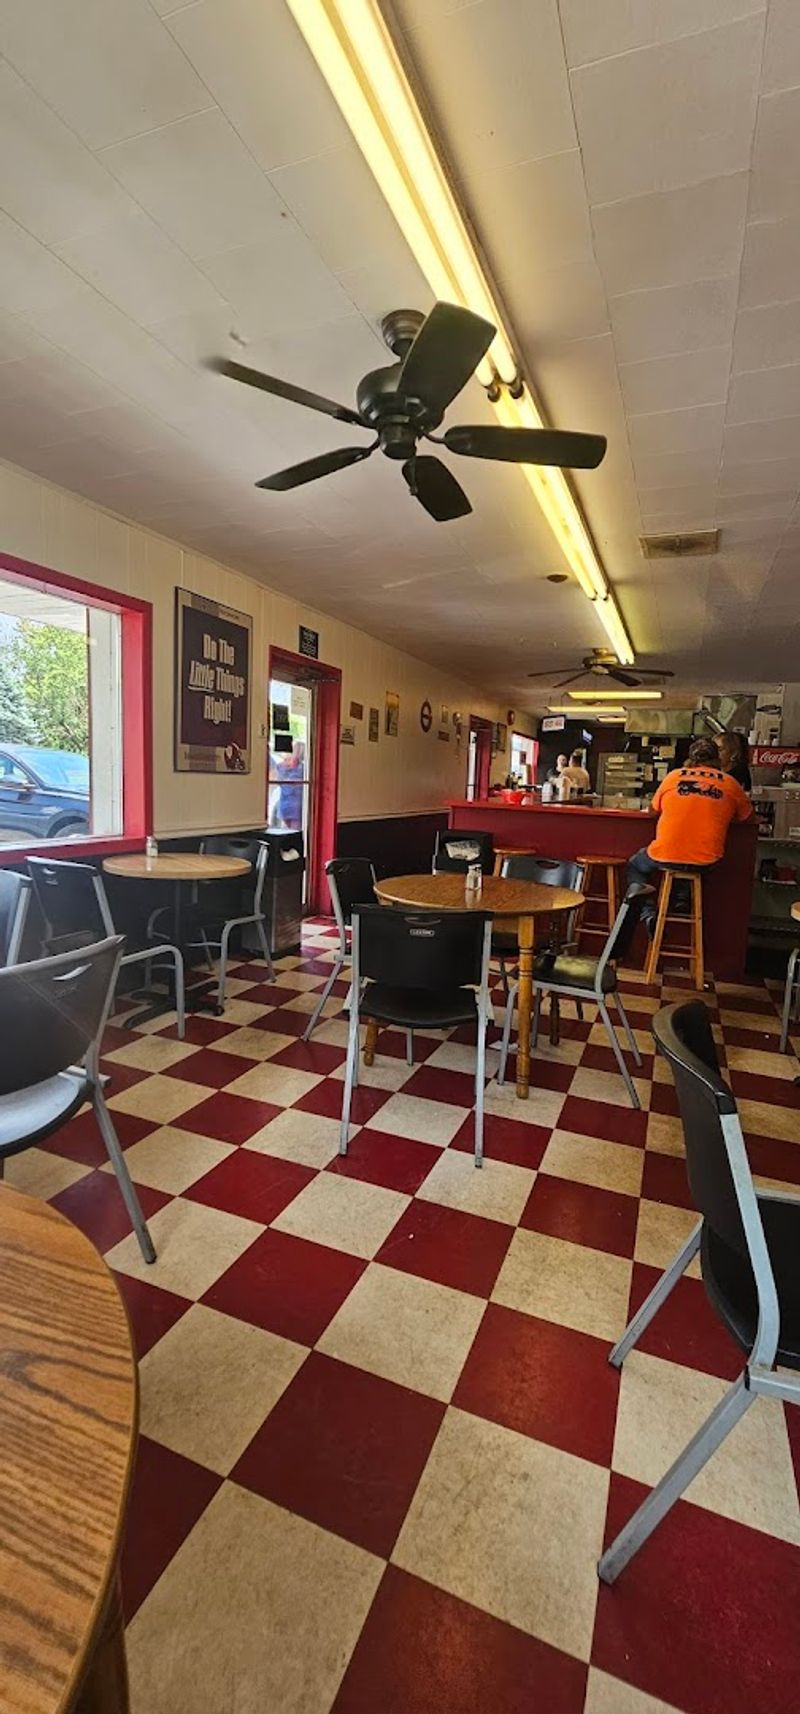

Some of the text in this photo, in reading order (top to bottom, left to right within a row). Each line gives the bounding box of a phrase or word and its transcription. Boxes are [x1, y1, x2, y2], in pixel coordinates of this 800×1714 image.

[203, 633, 235, 666] Do The
[189, 660, 246, 698] Little Things
[204, 695, 232, 724] Right!
